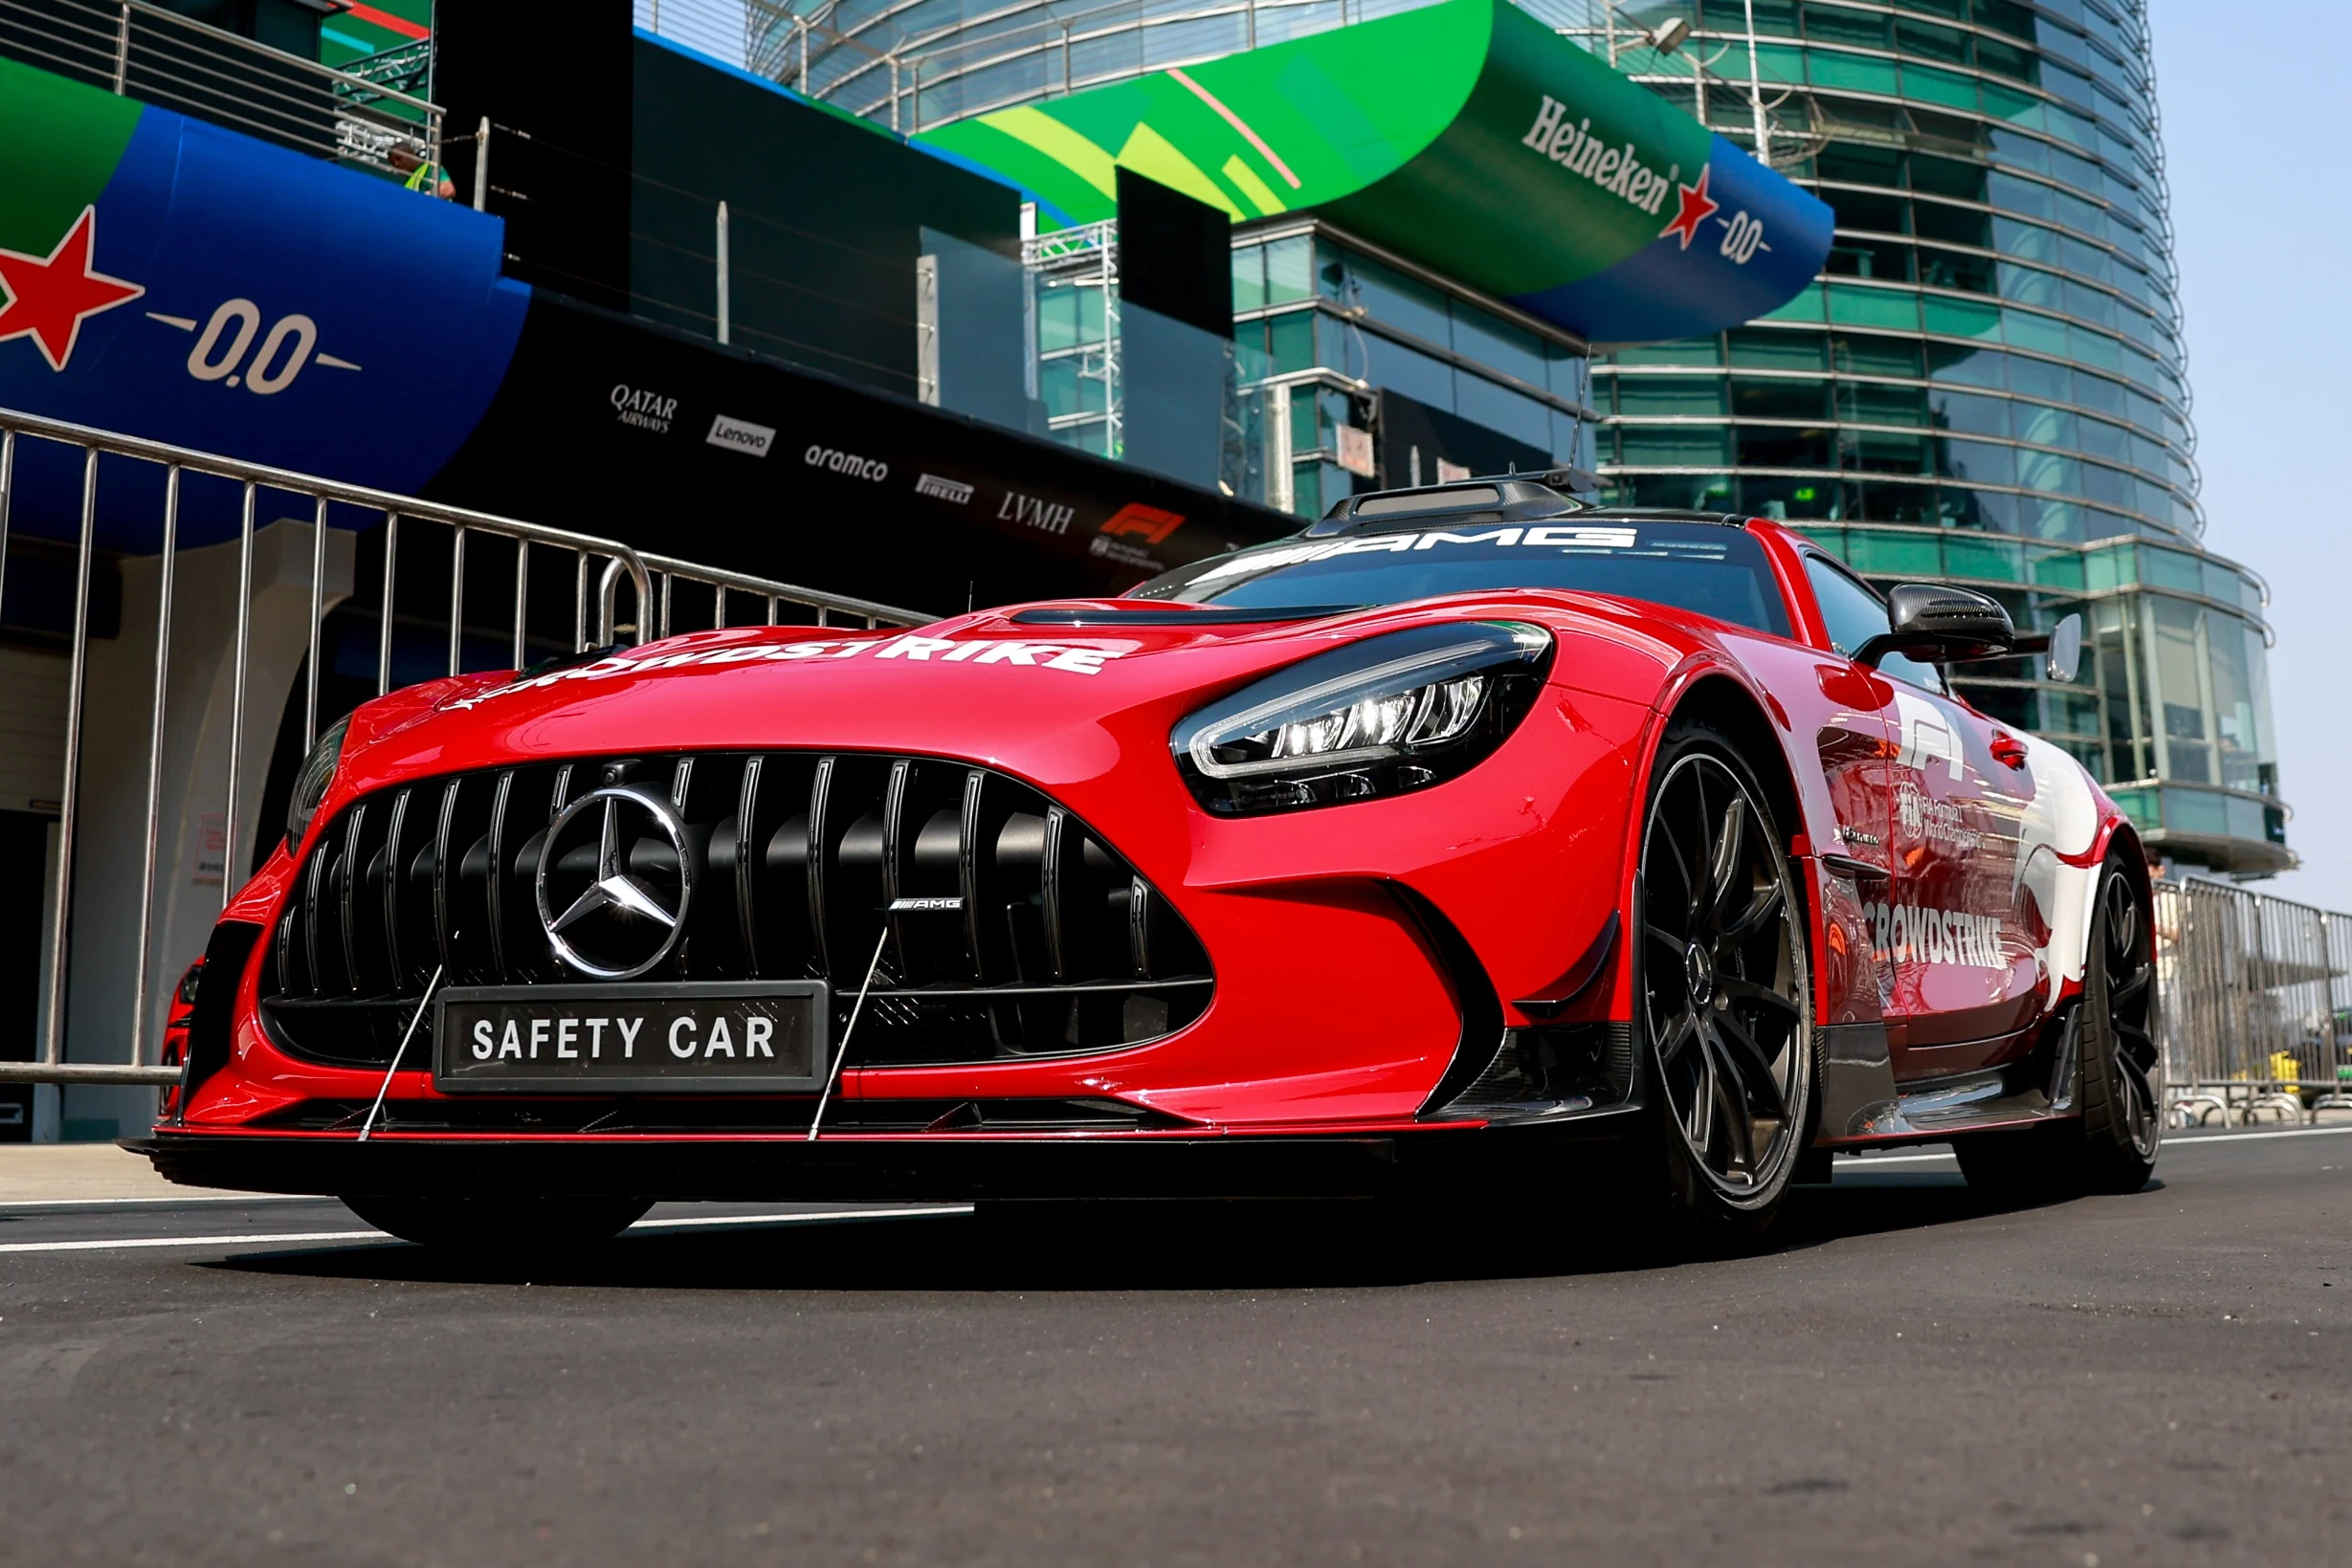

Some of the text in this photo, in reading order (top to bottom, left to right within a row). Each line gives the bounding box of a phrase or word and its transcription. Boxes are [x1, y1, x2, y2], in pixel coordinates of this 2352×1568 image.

[1521, 94, 1670, 216] Heineken
[610, 384, 678, 420] QATAR
[617, 409, 671, 433] AIRWAYS
[715, 422, 766, 449] Lenovo
[804, 444, 889, 482] aramco
[914, 472, 975, 505] PIRELLI
[997, 491, 1076, 535] LVMH
[1863, 901, 2008, 970] CROWDSTRIKE
[472, 1016, 775, 1060] SAFETY CAR
